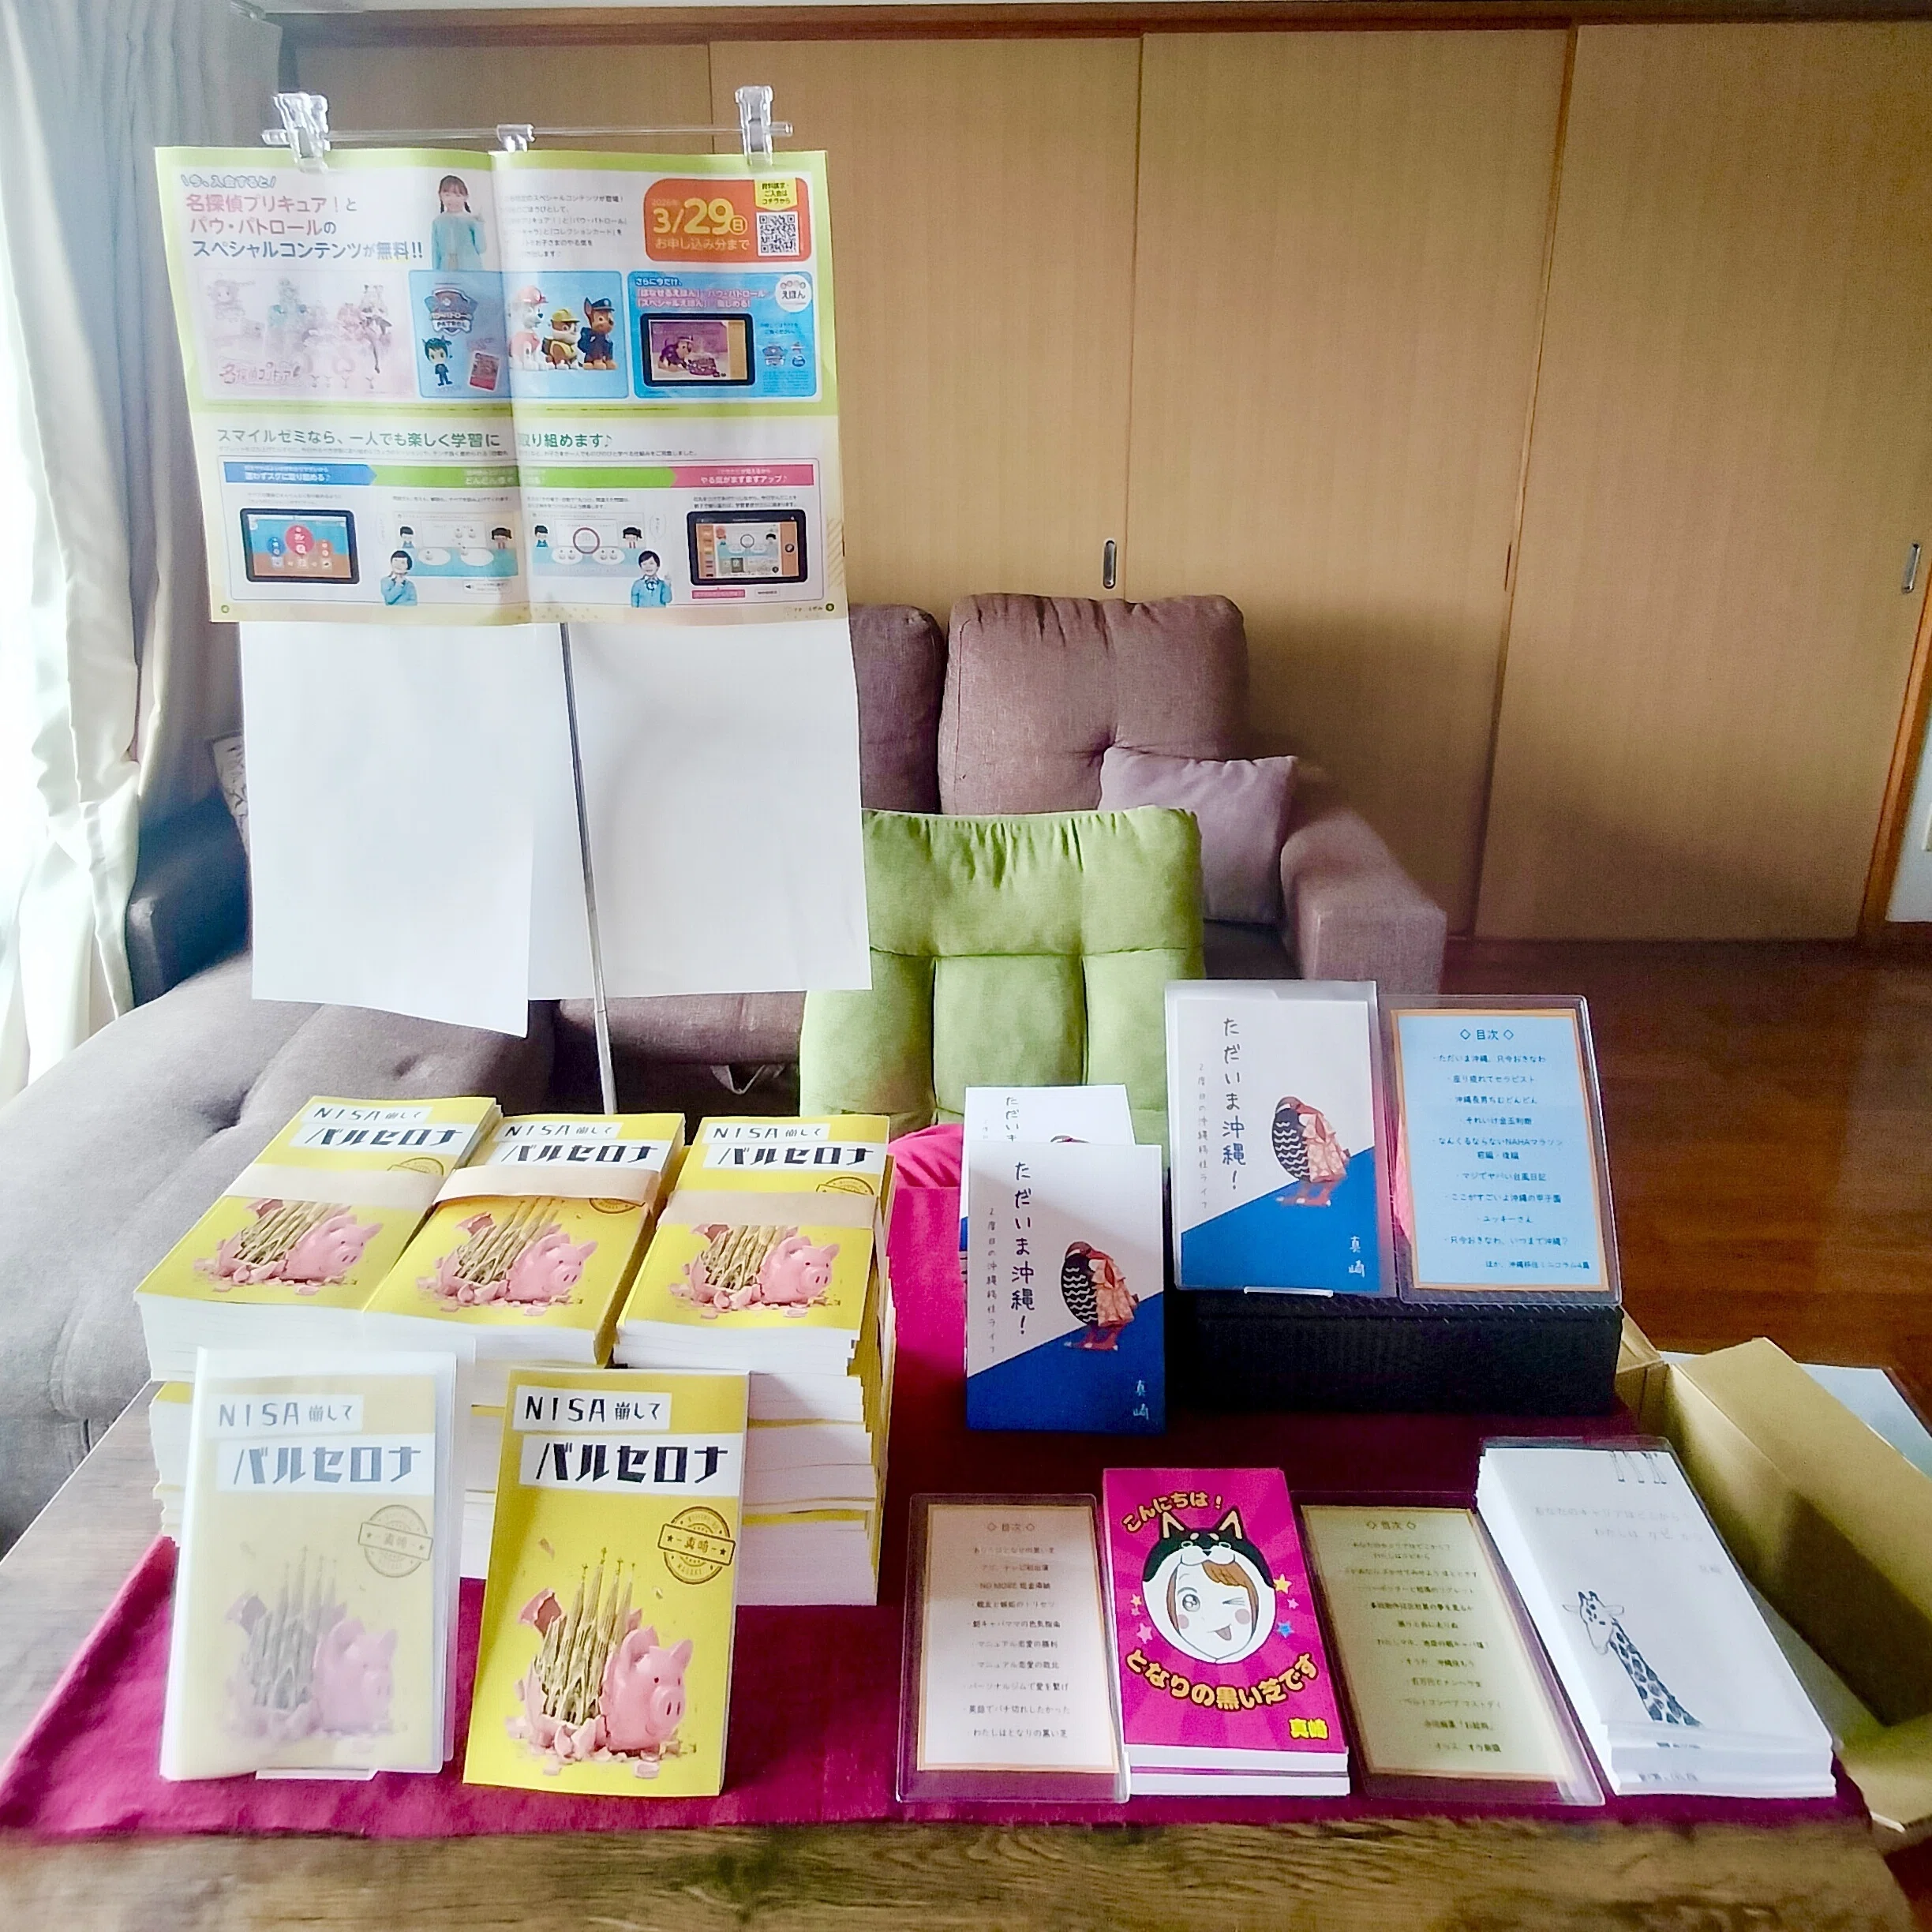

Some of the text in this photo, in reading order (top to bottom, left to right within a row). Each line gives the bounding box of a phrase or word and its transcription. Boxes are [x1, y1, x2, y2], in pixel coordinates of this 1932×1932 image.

[185, 194, 358, 213] 名探偵プリキュア！と
[189, 218, 337, 236] パウ・パトロールの
[192, 241, 424, 260] スペシャルコンテンツが無料!!
[655, 238, 749, 251] お申し込み分まで
[781, 290, 806, 300] えほん
[217, 429, 500, 448] スマイルゼミなら、一人でも楽しく学習に
[1476, 1028, 1500, 1041] 目次
[1222, 1017, 1246, 1190] ただいま沖縄！
[304, 1127, 463, 1147] バルセロナ
[500, 1144, 659, 1163] バルセロナ
[717, 1147, 874, 1166] バルセロナ
[1010, 1162, 1035, 1335] ただいま沖縄！
[233, 1446, 422, 1485] バルセロナ
[535, 1441, 728, 1484] バルセロナ
[1121, 1492, 1222, 1532] こんにちは！
[1126, 1649, 1319, 1711] となりの黒い芝です
